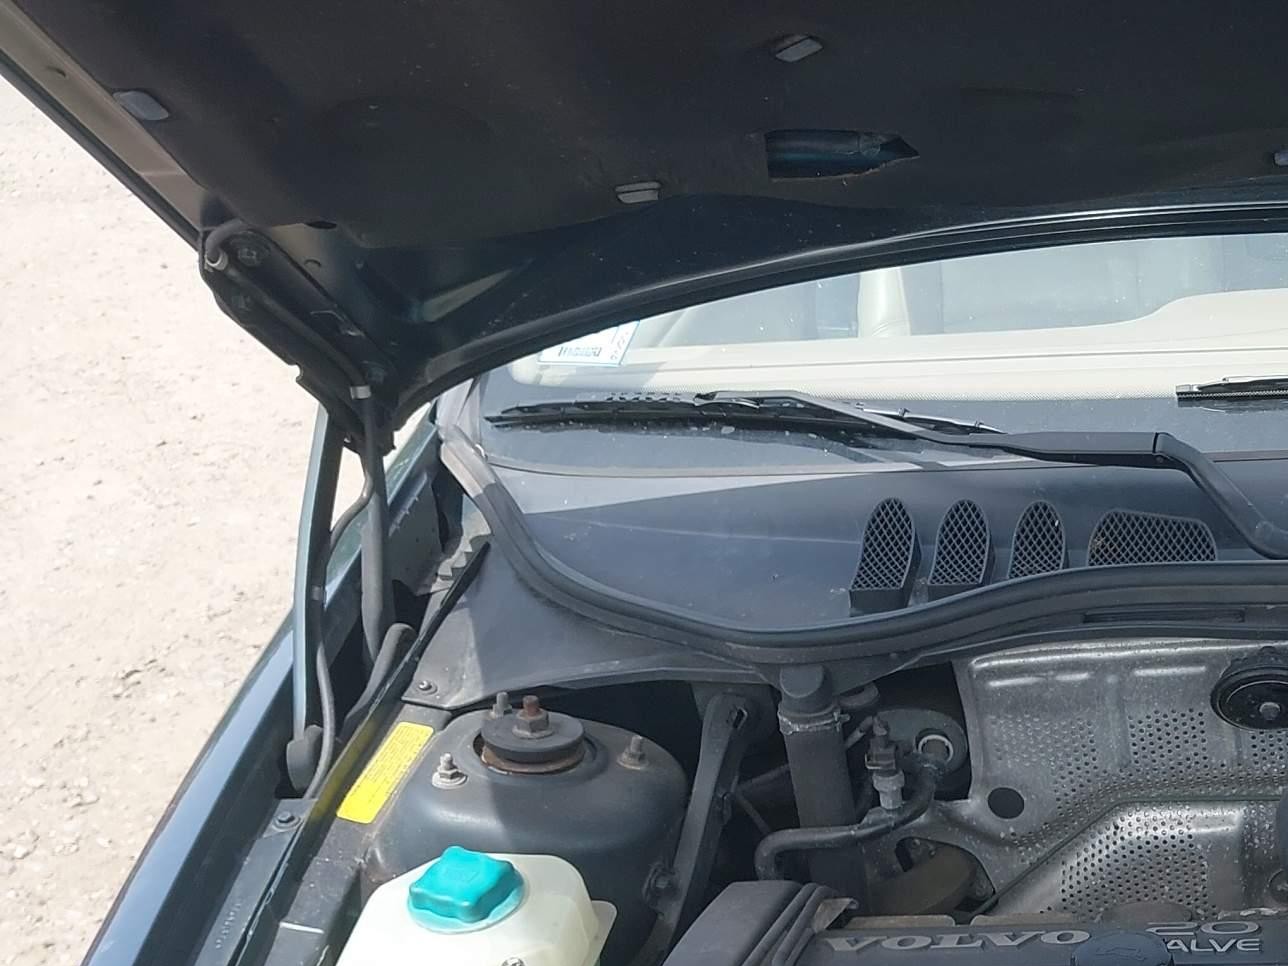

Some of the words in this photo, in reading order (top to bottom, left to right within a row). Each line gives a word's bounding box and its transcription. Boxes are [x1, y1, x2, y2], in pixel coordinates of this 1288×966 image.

[1145, 921, 1259, 936] 20
[825, 930, 1091, 951] VOLVO
[1164, 938, 1260, 952] ALVE
